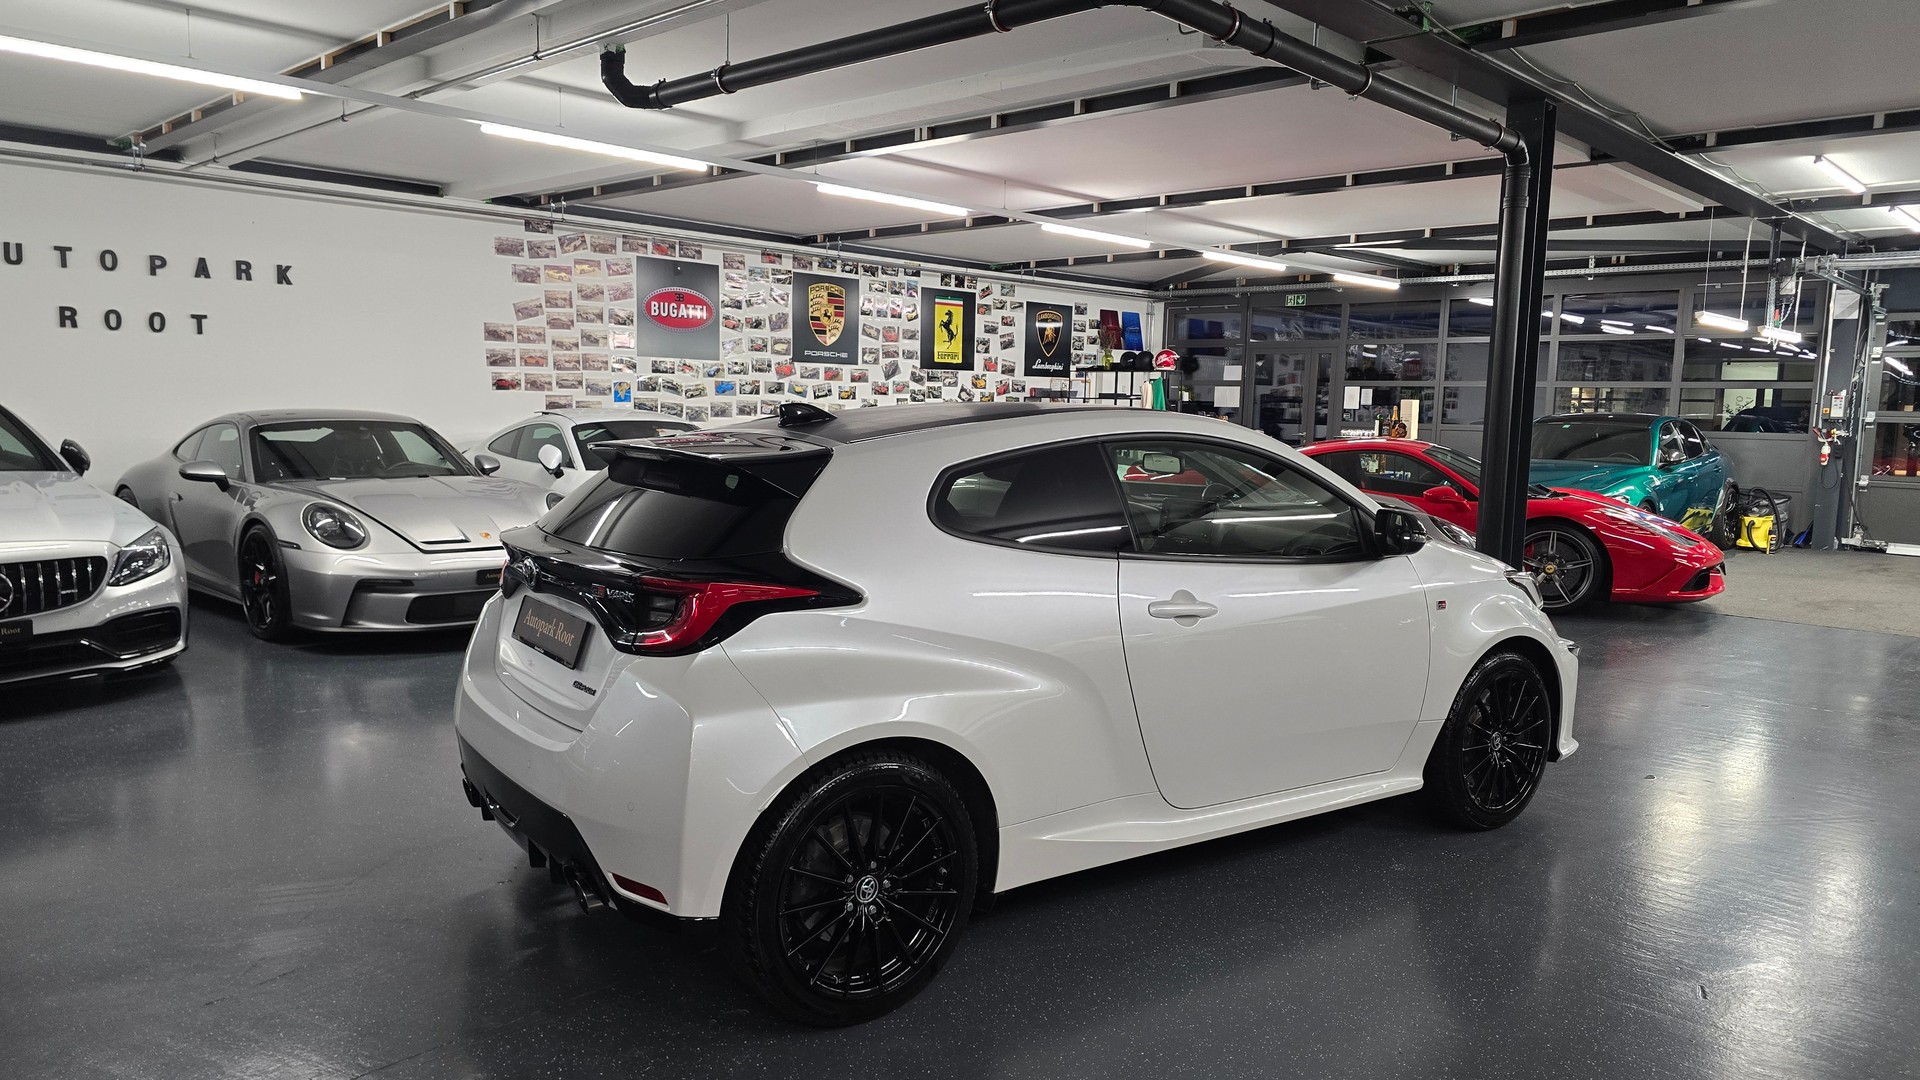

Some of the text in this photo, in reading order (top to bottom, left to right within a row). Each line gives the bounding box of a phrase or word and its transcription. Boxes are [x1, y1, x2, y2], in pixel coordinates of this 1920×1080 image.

[2, 241, 293, 286] UTOPARK
[650, 301, 707, 320] BUGATTI
[58, 306, 208, 335] ROOT
[804, 350, 848, 358] PORSCHE
[937, 351, 960, 361] Ferrari
[1031, 358, 1064, 372] Lamborghini
[523, 608, 575, 647] Autopark Root
